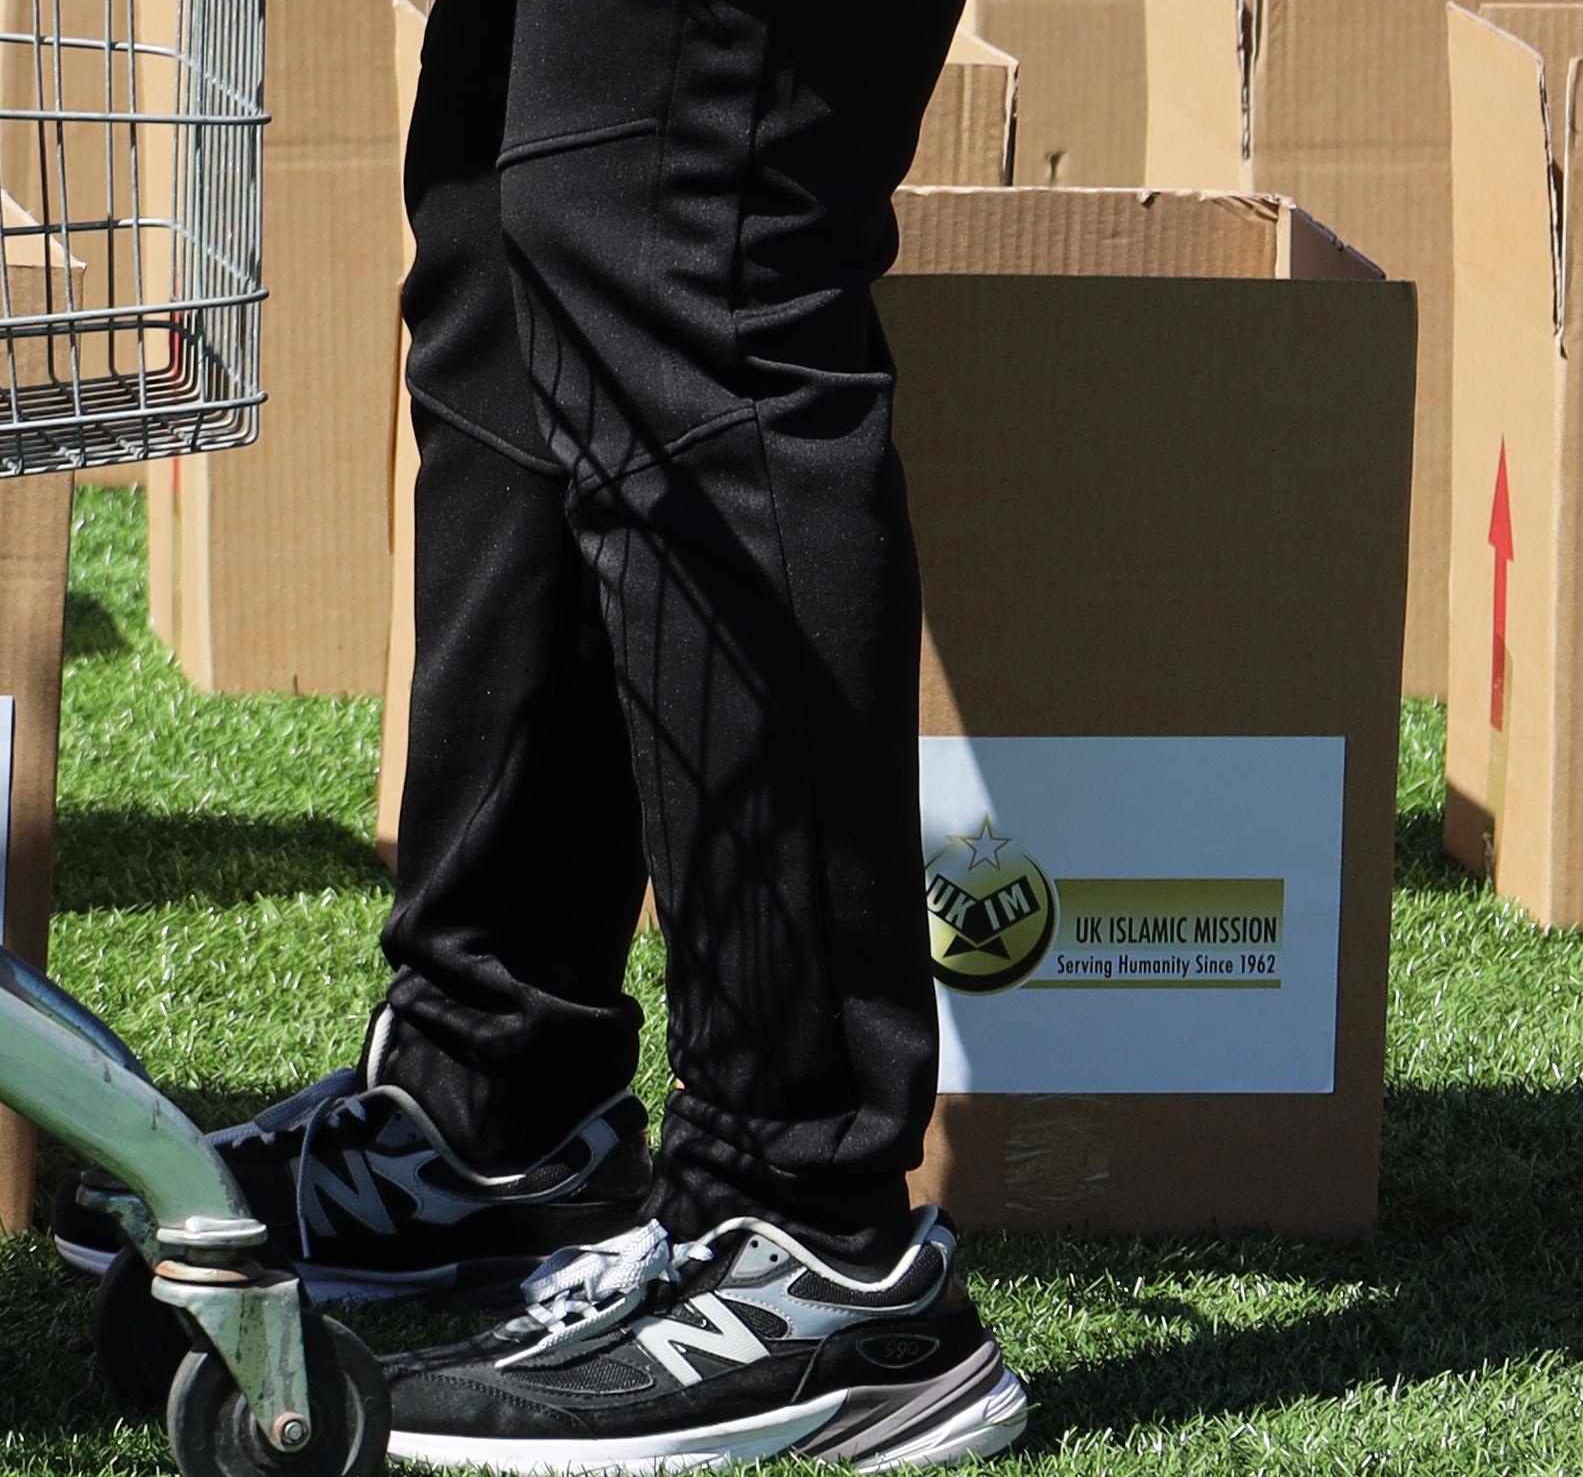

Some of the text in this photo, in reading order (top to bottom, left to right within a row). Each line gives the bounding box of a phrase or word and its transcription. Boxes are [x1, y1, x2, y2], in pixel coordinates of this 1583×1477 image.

[928, 878, 1032, 930] UKIM
[1075, 916, 1277, 944] UK ISLAMIC MISSION
[1057, 954, 1276, 979] Serving Humanity Since 1962
[883, 1340, 920, 1359] 990
